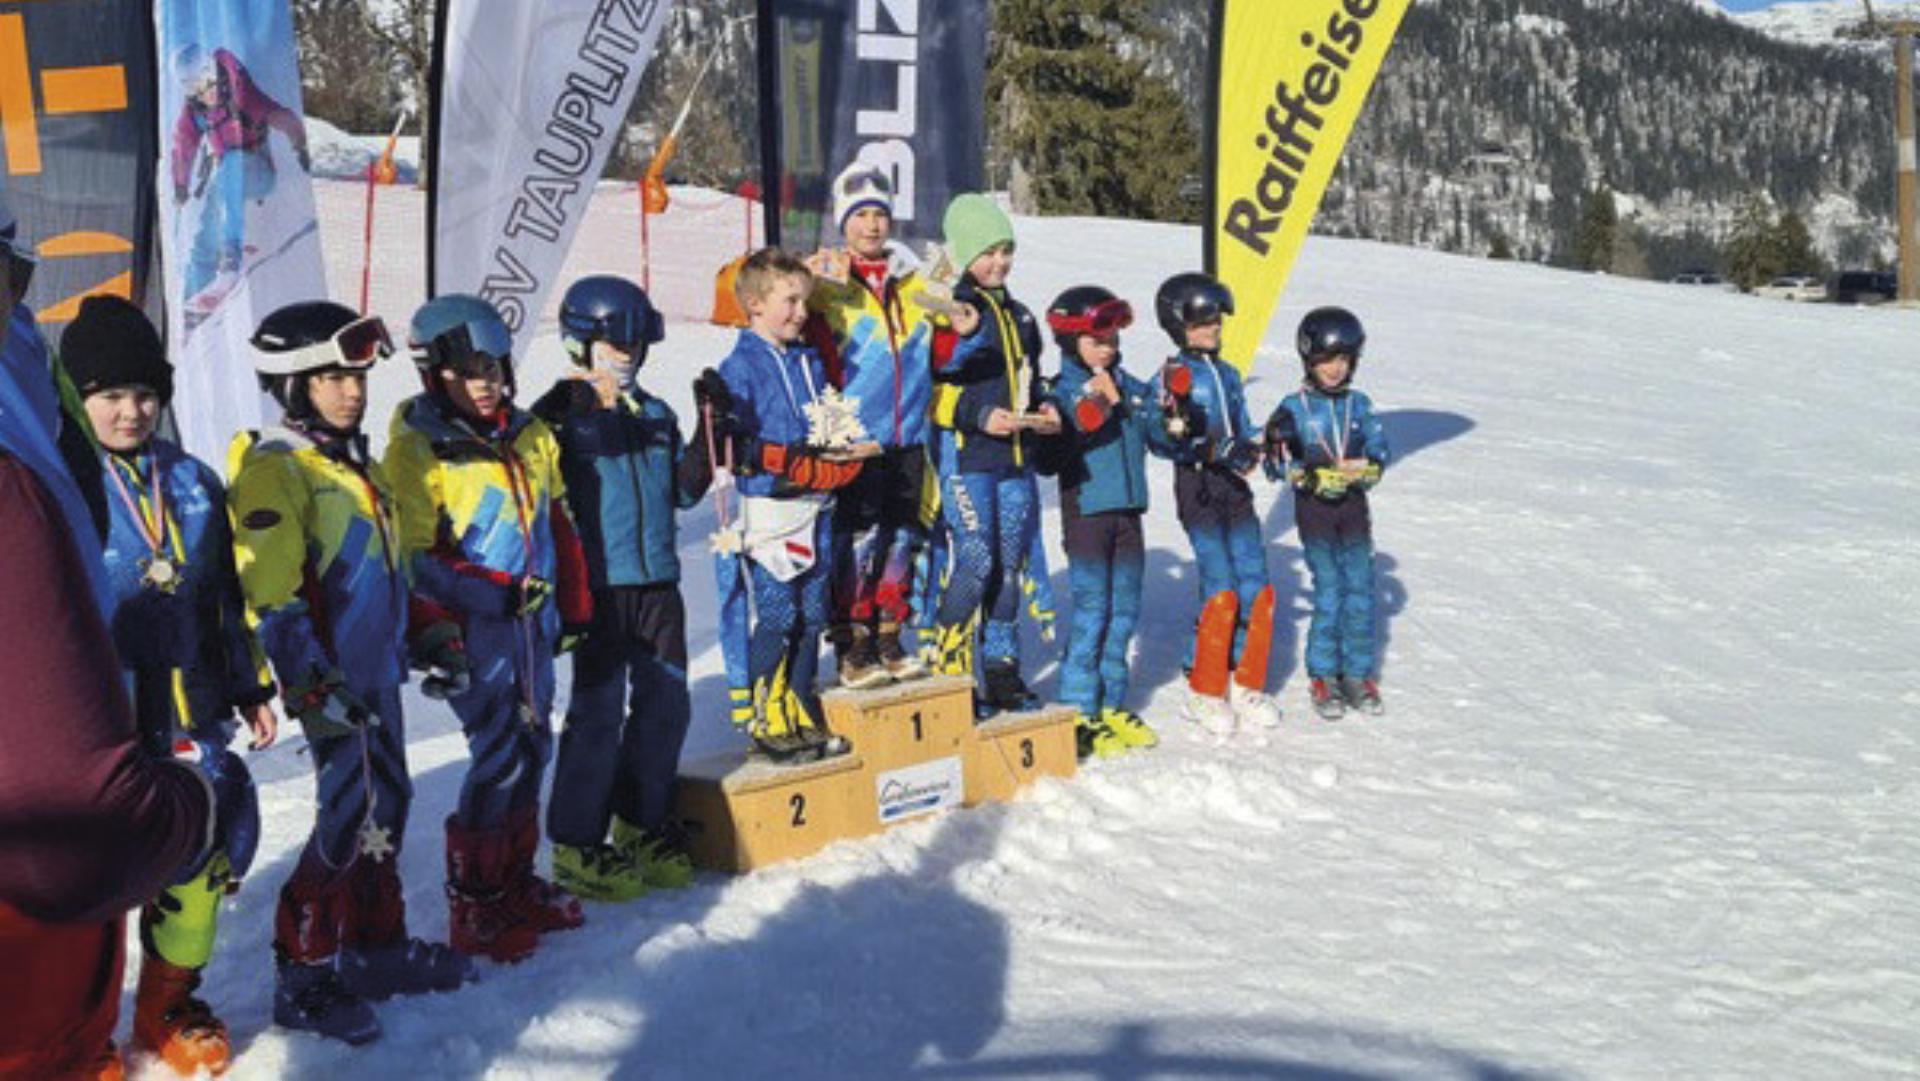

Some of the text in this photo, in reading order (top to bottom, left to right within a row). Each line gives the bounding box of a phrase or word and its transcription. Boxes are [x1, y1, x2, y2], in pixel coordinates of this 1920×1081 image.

[911, 711, 922, 741] 1
[1020, 738, 1034, 768] 3
[789, 792, 806, 827] 2
